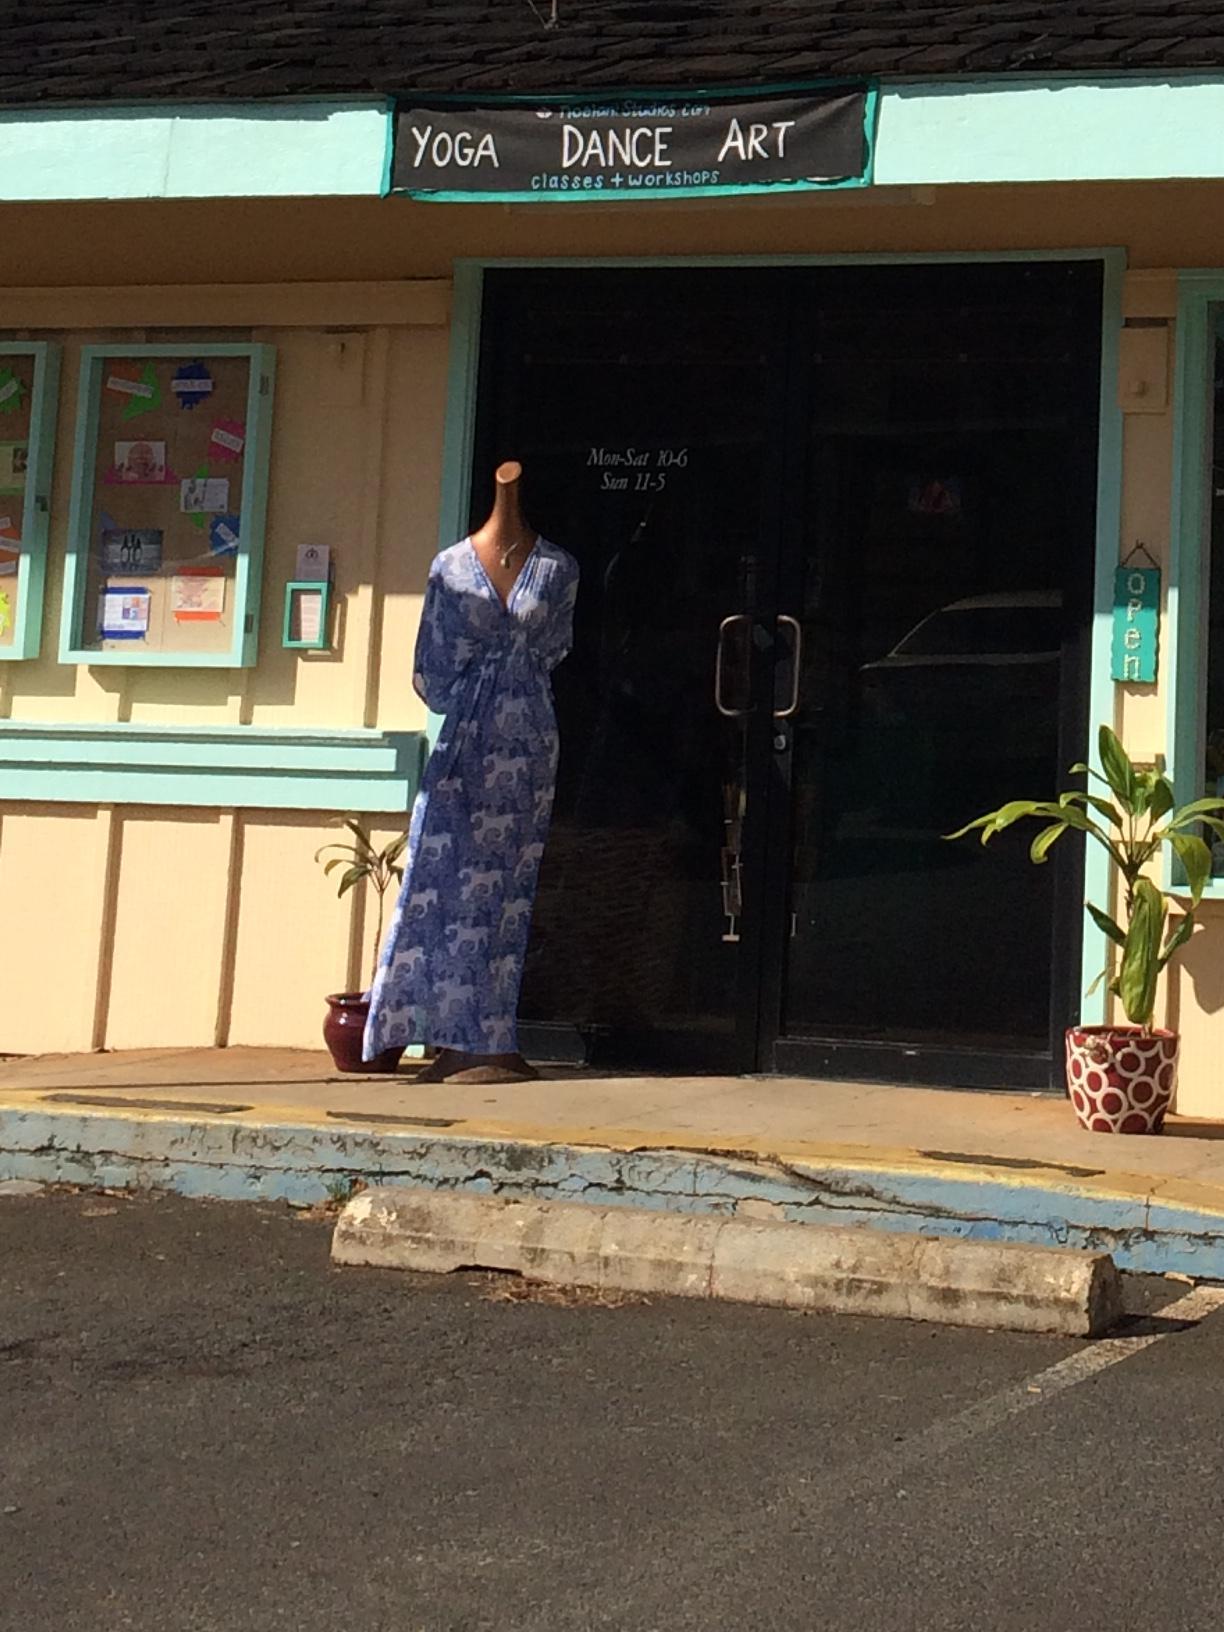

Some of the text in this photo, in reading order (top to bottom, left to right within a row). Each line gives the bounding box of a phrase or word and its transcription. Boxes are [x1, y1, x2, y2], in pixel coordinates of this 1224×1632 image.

[411, 118, 795, 168] YOGA DANCE ART
[531, 171, 604, 191] classes
[628, 169, 720, 187] workshops
[586, 448, 688, 467] Mon-Sat 10-6
[600, 472, 666, 491] Sun 11-5
